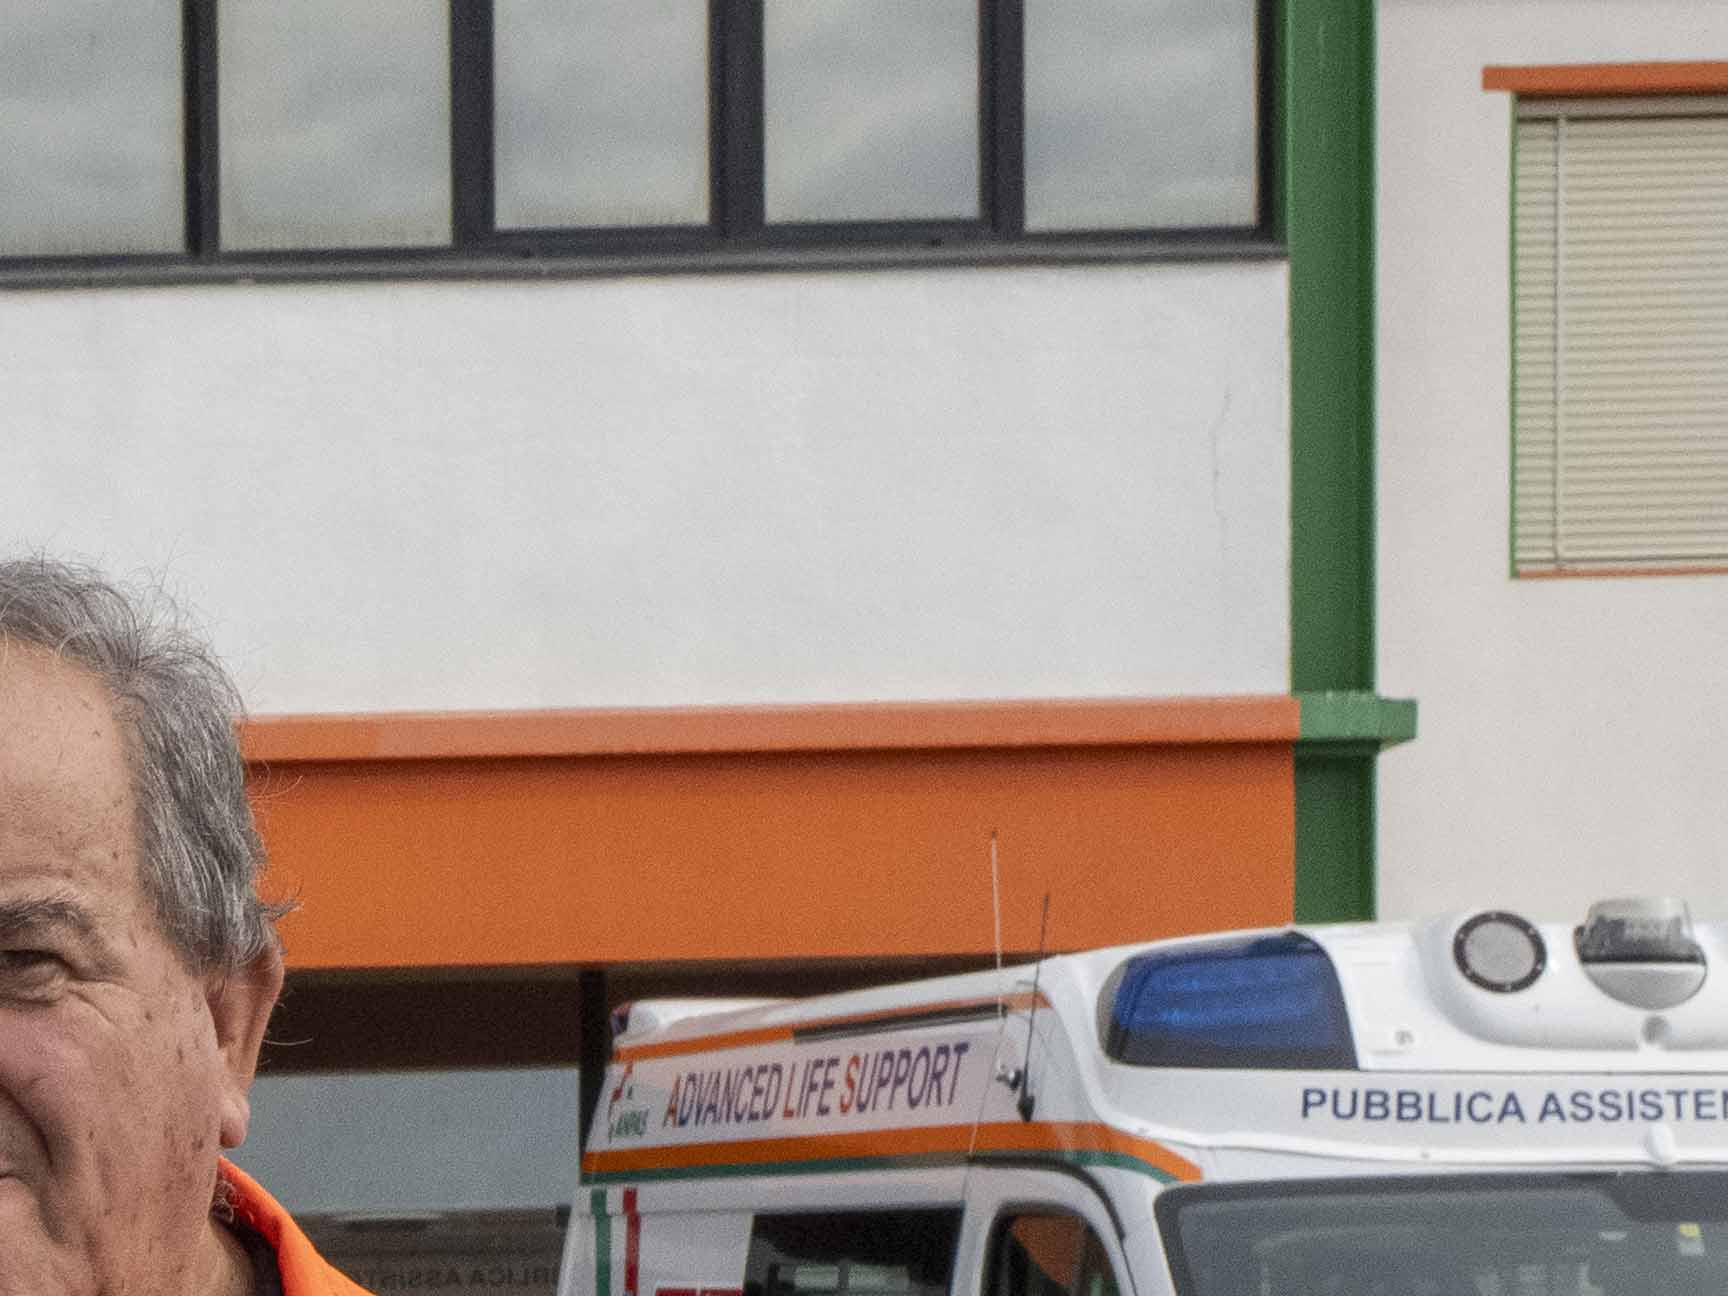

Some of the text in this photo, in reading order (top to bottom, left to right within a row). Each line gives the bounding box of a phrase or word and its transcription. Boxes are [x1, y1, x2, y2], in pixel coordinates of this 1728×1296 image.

[664, 1042, 969, 1128] ADVANCED LIFE SUPPORT
[1301, 1087, 1728, 1124] PUBBLICA ASSISTE
